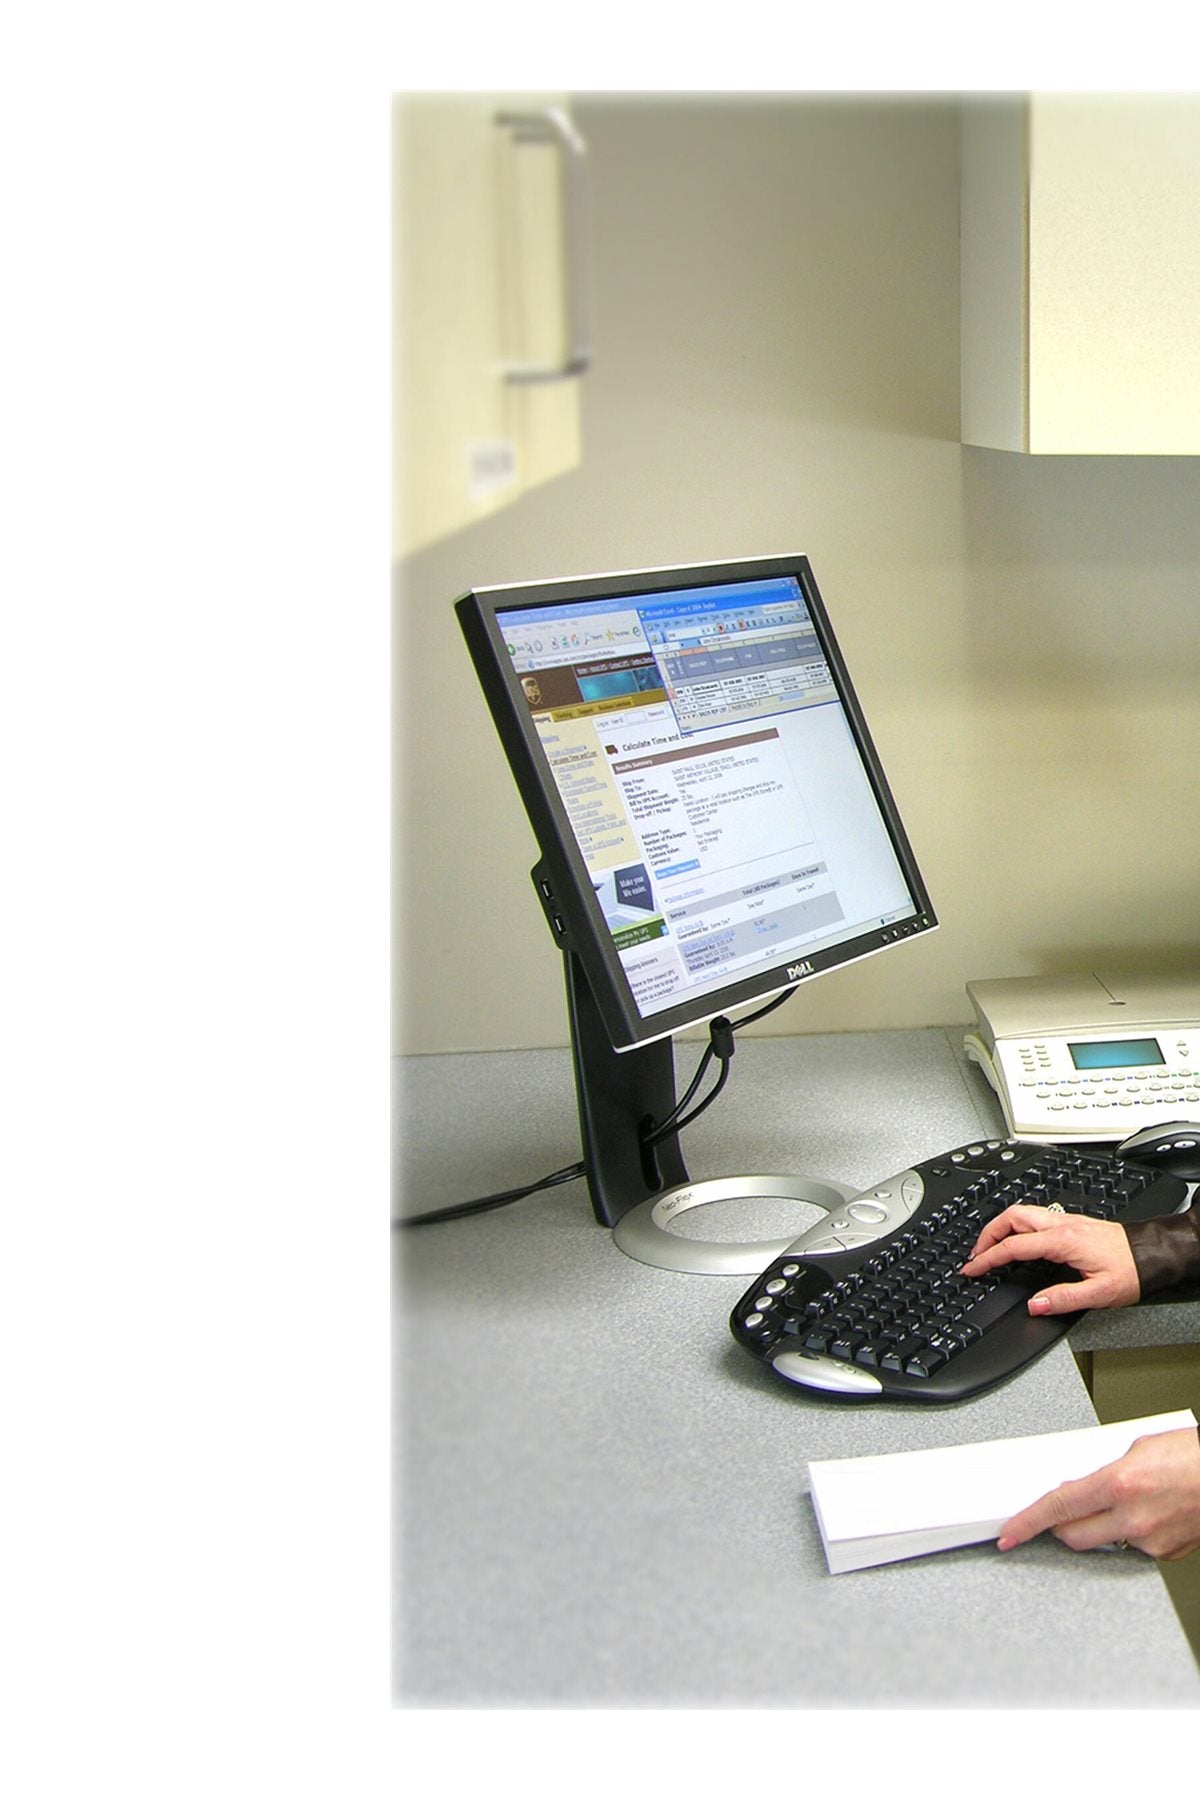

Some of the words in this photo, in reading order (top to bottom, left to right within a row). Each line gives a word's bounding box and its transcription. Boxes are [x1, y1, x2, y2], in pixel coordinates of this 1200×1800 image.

[622, 739, 651, 750] Calculate
[652, 736, 667, 744] Time
[627, 791, 646, 799] Shipment
[641, 831, 659, 839] Address
[644, 838, 661, 846] Number
[620, 878, 633, 888] Make
[633, 875, 644, 884] your
[670, 910, 686, 918] Service
[678, 928, 702, 940] Guaranteed
[786, 961, 814, 980] DELL
